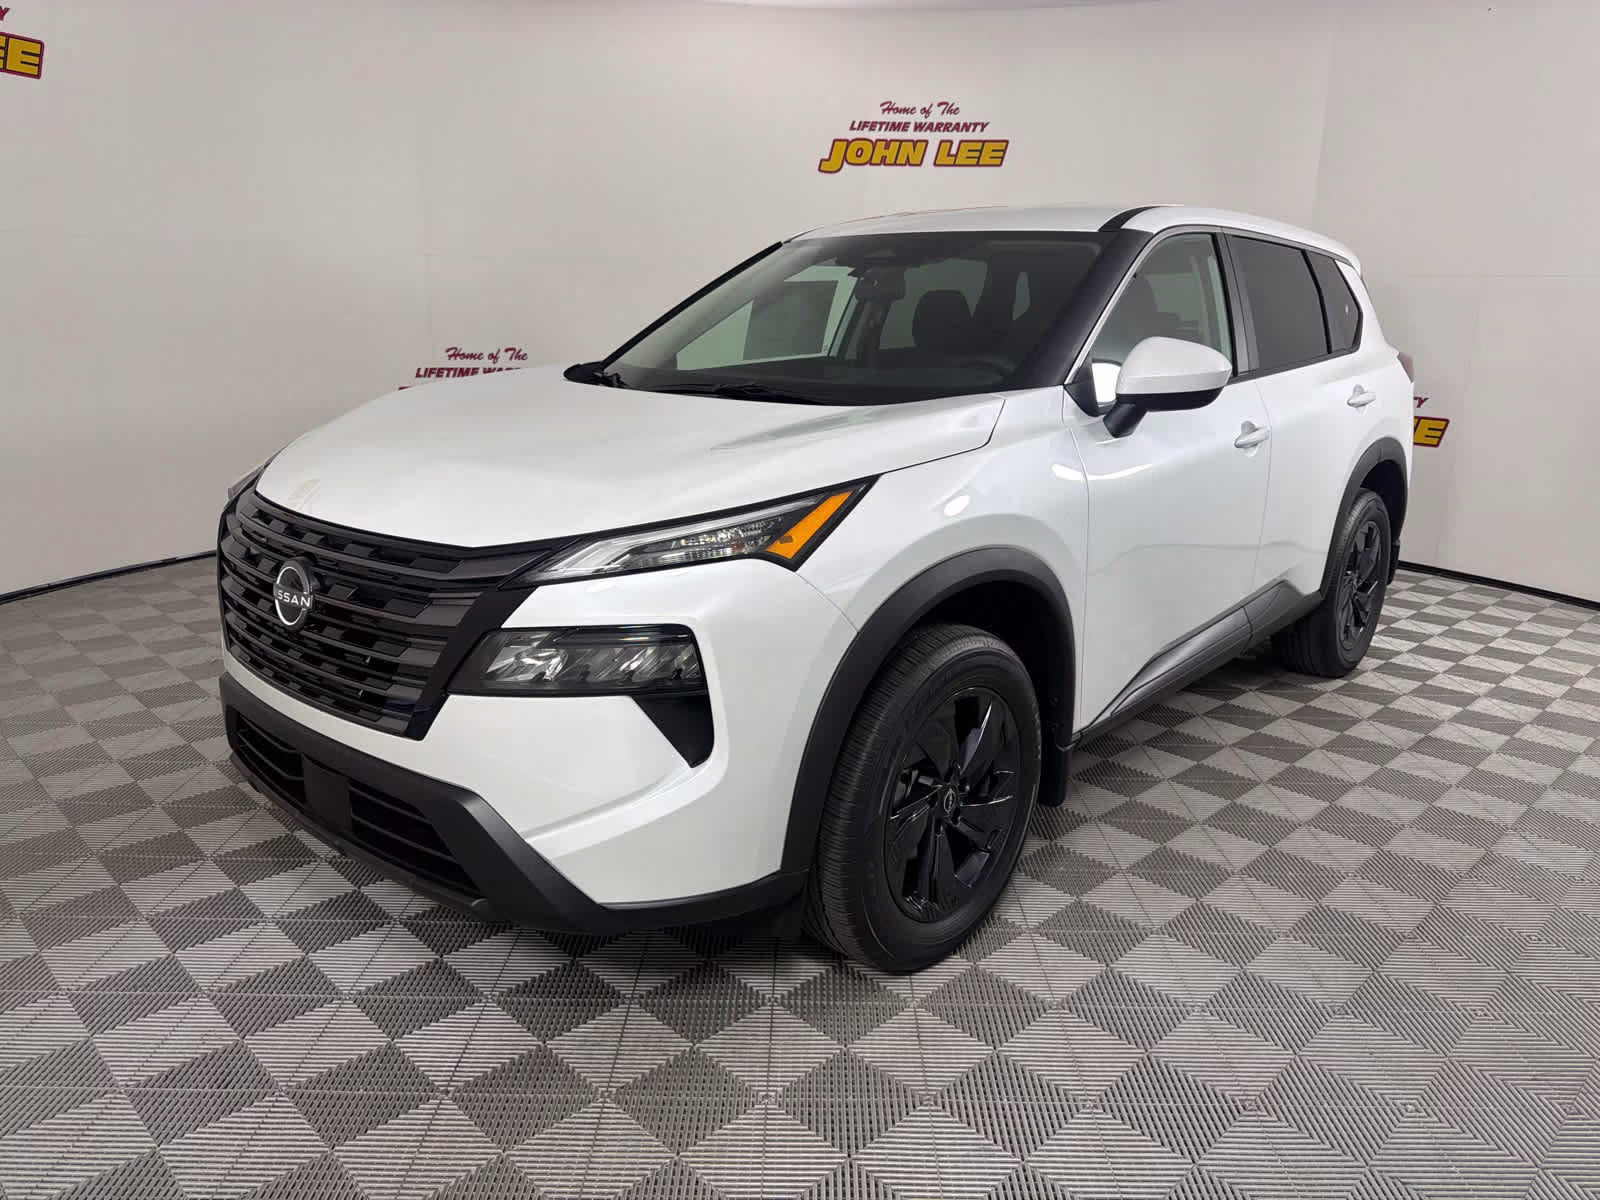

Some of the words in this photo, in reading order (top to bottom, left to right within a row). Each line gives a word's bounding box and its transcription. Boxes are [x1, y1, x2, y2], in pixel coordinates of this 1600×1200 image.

[880, 101, 917, 115] Home
[920, 103, 933, 118] of
[937, 101, 960, 115] The
[849, 120, 911, 132] LIFETIME
[914, 121, 989, 133] WARRANTY
[818, 138, 928, 173] JOHN
[933, 139, 1009, 167] LEE
[445, 347, 484, 361] Home
[488, 350, 501, 364] of
[504, 347, 528, 361] The
[415, 367, 479, 378] LIFETIME
